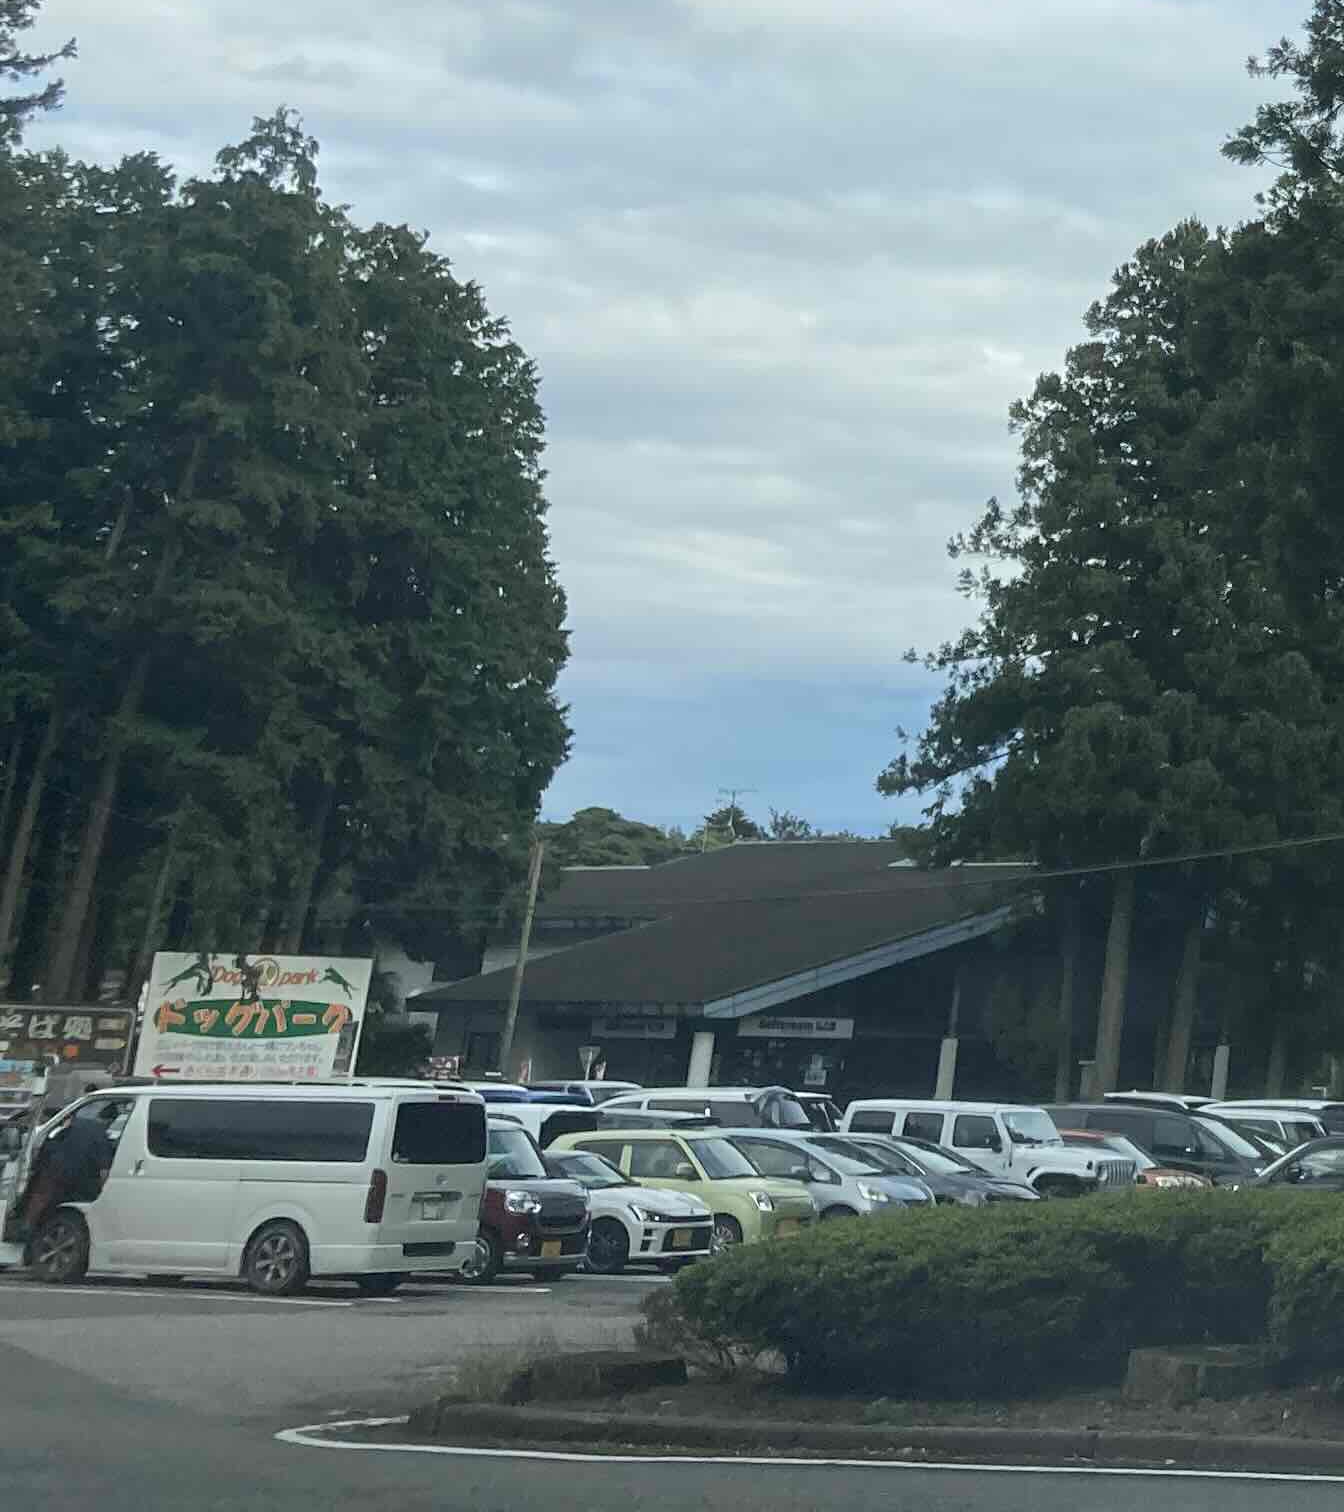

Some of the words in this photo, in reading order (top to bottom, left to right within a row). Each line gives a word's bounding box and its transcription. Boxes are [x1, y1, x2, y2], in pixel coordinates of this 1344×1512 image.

[159, 997, 350, 1037] ドッグパーク
